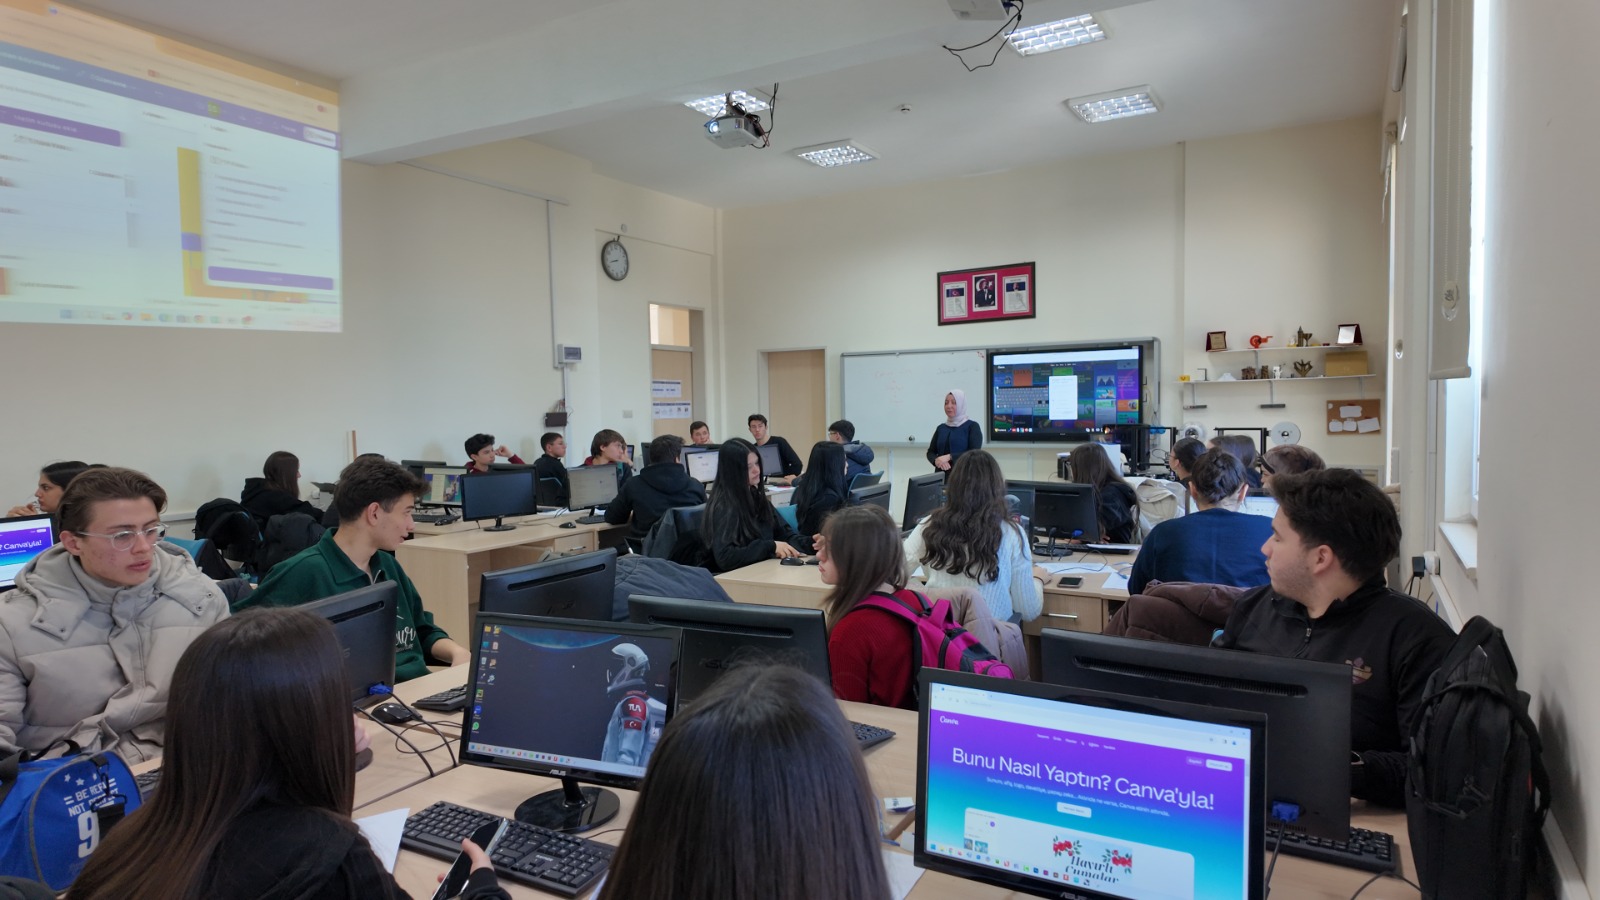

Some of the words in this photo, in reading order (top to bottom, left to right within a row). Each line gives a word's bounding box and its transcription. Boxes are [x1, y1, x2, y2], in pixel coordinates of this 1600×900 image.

[549, 769, 567, 777] ASUS
[952, 747, 995, 770] Bunu
[999, 756, 1041, 779] Nasıl
[1044, 764, 1111, 791] Yaptın?
[1114, 777, 1214, 810] Canva'yla!
[75, 788, 89, 801] BE
[68, 802, 86, 817] NOT
[78, 809, 100, 859] 9
